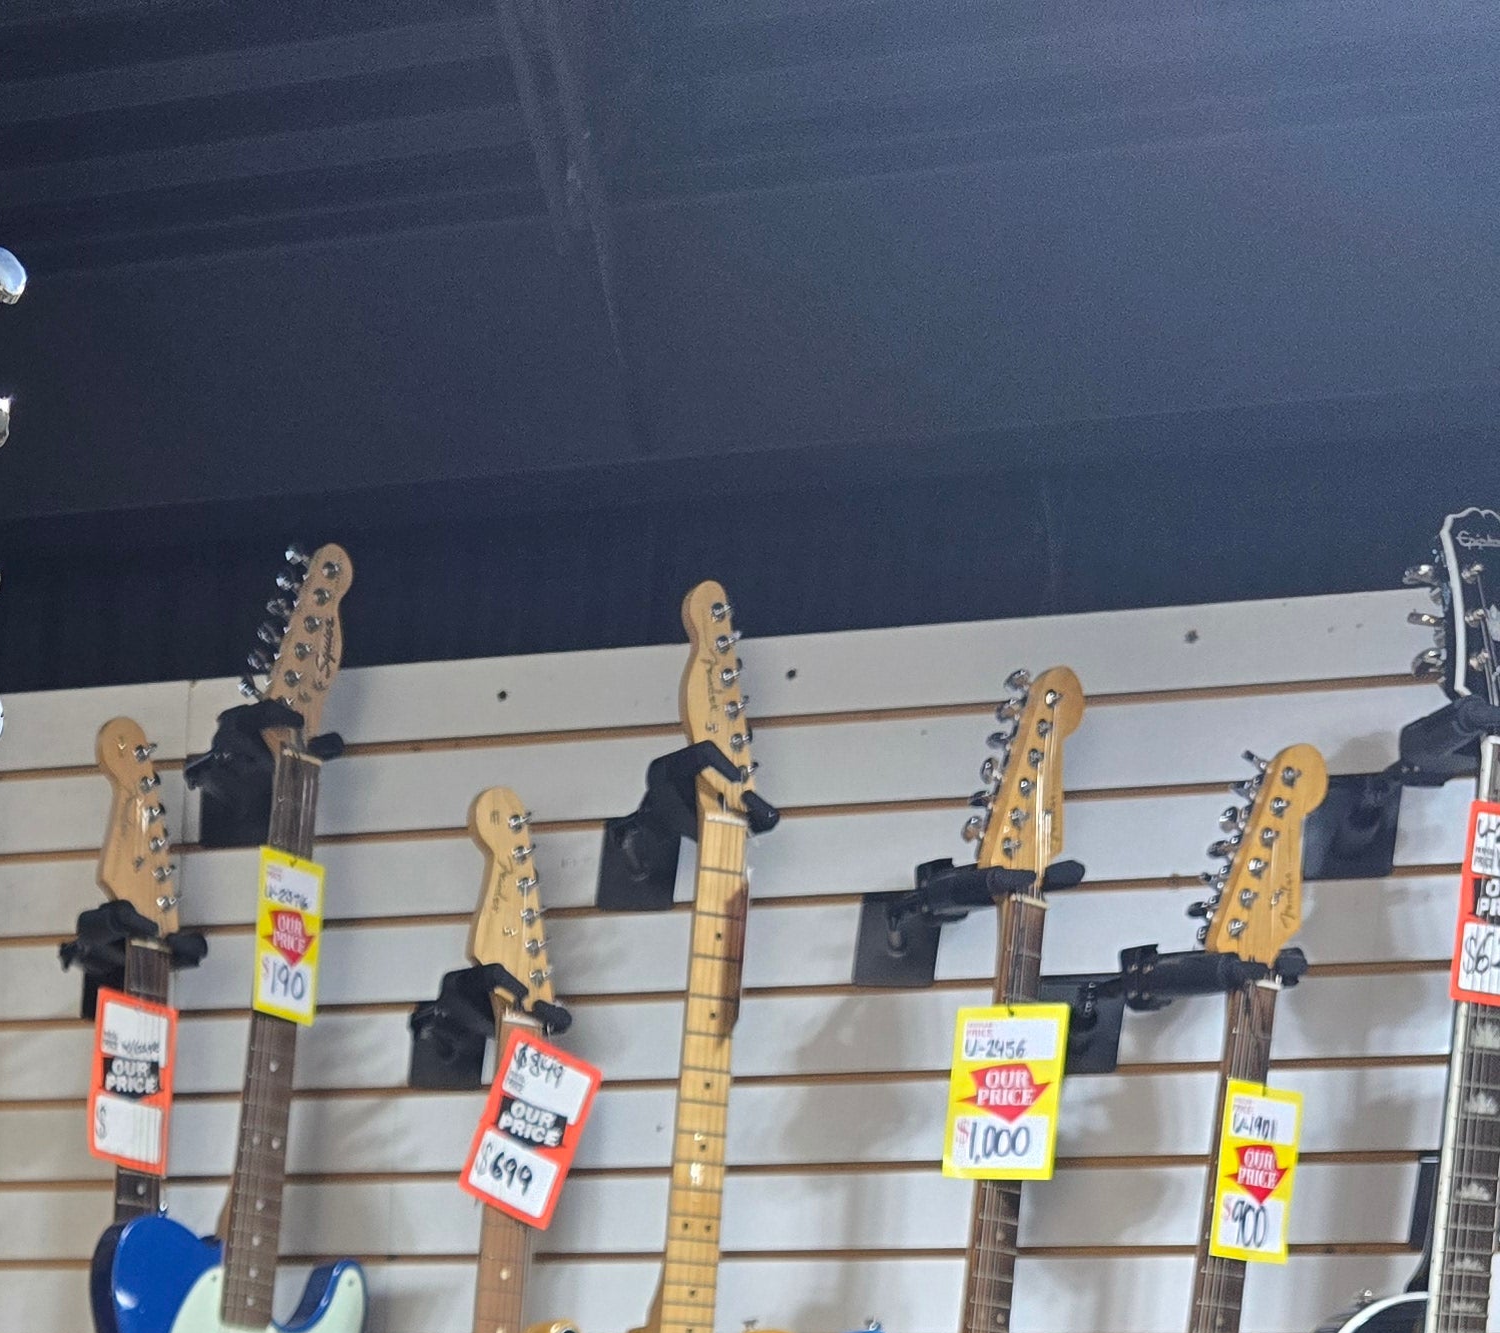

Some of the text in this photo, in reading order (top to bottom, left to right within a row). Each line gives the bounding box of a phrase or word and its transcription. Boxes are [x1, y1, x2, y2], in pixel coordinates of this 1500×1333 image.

[277, 913, 303, 936] OUR
[273, 931, 306, 956] PRICE
[111, 1058, 149, 1077] OUR
[985, 1069, 1031, 1090] OUR
[105, 1071, 160, 1094] PRICE
[977, 1087, 1039, 1107] PRICE
[510, 1099, 557, 1129] OUR
[498, 1111, 563, 1148] PRICE
[476, 1141, 533, 1196] $699
[1244, 1147, 1276, 1172] OUR
[1237, 1166, 1278, 1190] PRICE
